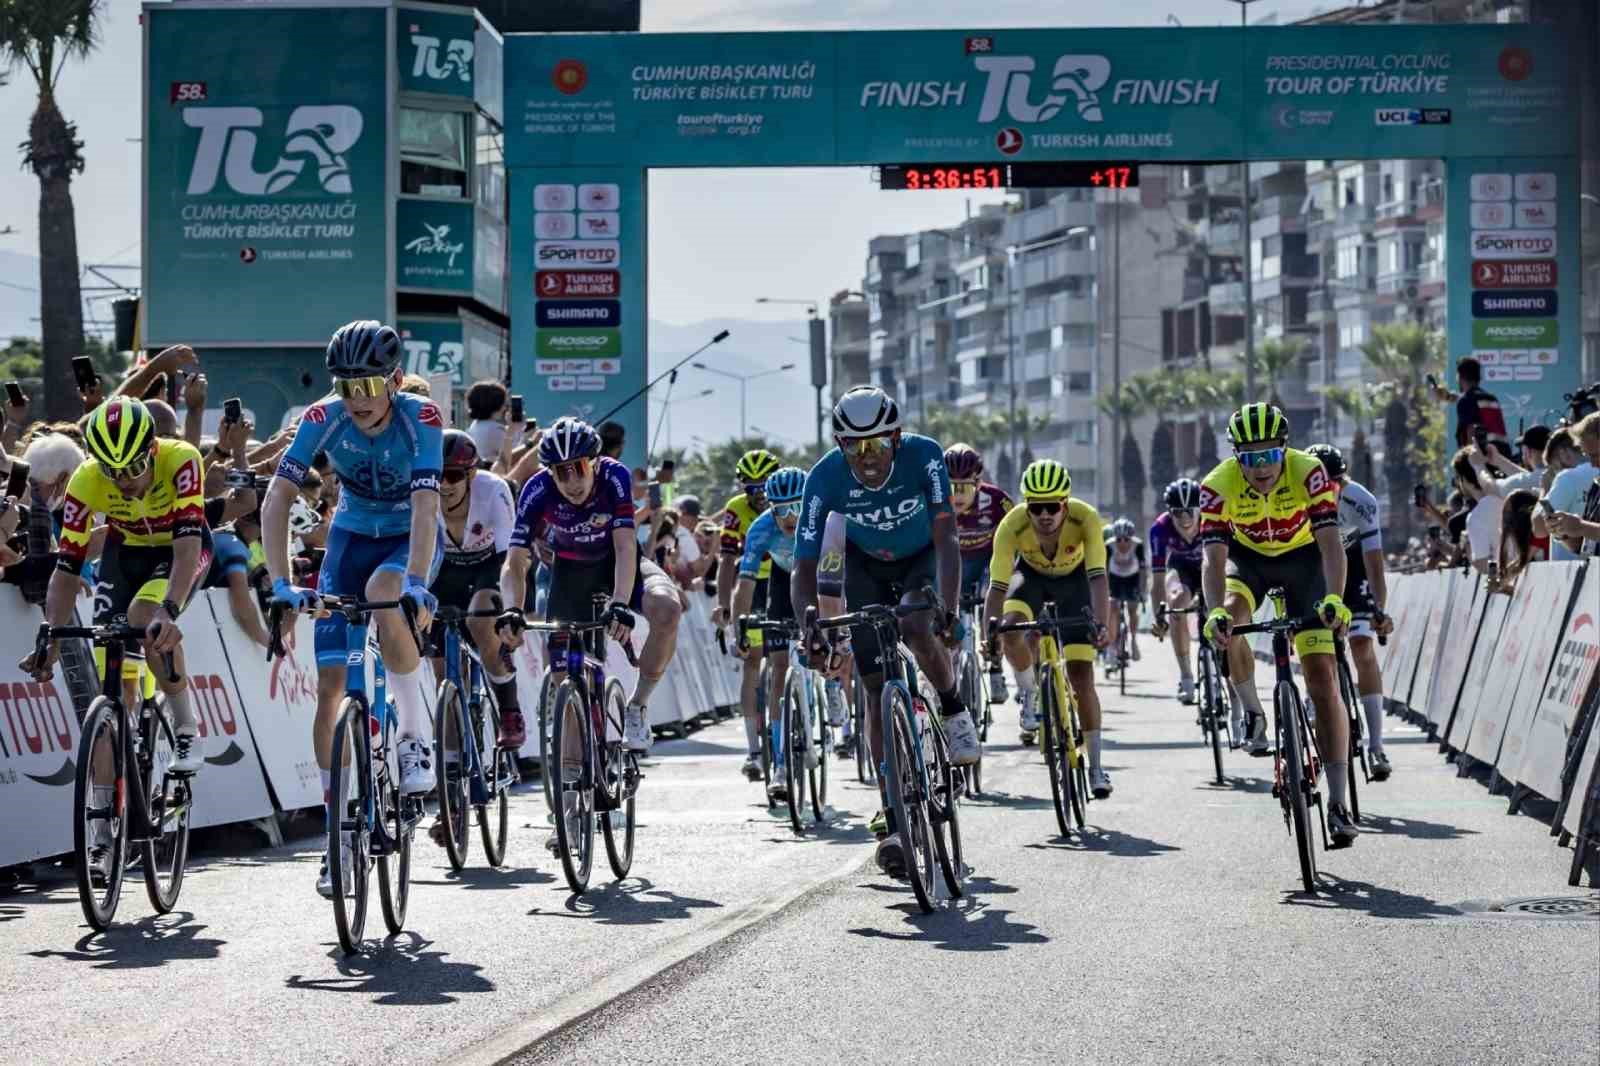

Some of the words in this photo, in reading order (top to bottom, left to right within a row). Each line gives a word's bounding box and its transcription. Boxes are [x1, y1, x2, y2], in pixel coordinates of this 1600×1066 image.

[1265, 54, 1380, 71] PRESIDENTIAL
[1381, 53, 1450, 69] CYCLING
[631, 61, 816, 82] CUMHURBAŞKANLIĞI
[973, 54, 1112, 123] TUR
[1265, 76, 1321, 95] TOUR
[1327, 76, 1355, 94] OF
[1359, 71, 1449, 93] TÜRKİYE
[177, 83, 206, 101] 58.
[632, 84, 696, 101] TÜRKİYE
[699, 84, 767, 100] BİSİKLET
[772, 85, 813, 99] TURU
[860, 80, 967, 108] FINISH
[1112, 79, 1221, 105] FINISH
[1379, 111, 1405, 122] UCI
[1031, 133, 1099, 147] TURKISH
[1103, 132, 1174, 147] AIRLINES
[182, 105, 364, 194] TUR
[906, 168, 1001, 189] 3:36:51
[1091, 167, 1131, 189] +17
[181, 199, 357, 222] CUMHURBAŞKANLIĞI
[183, 223, 245, 239] TÜRKİYE
[247, 222, 312, 238] BİSİKLET
[312, 224, 355, 238] TURU
[261, 250, 306, 260] TURKISH
[307, 249, 353, 260] AIRLINES
[1502, 263, 1551, 274] TURKISH
[565, 273, 614, 284] TURKISH
[1502, 273, 1552, 284] AIRLINES
[565, 283, 615, 294] AIRLINES
[1483, 298, 1546, 310] SHIMANO
[547, 307, 609, 320] SHIMANO
[0, 681, 72, 758] TOTO
